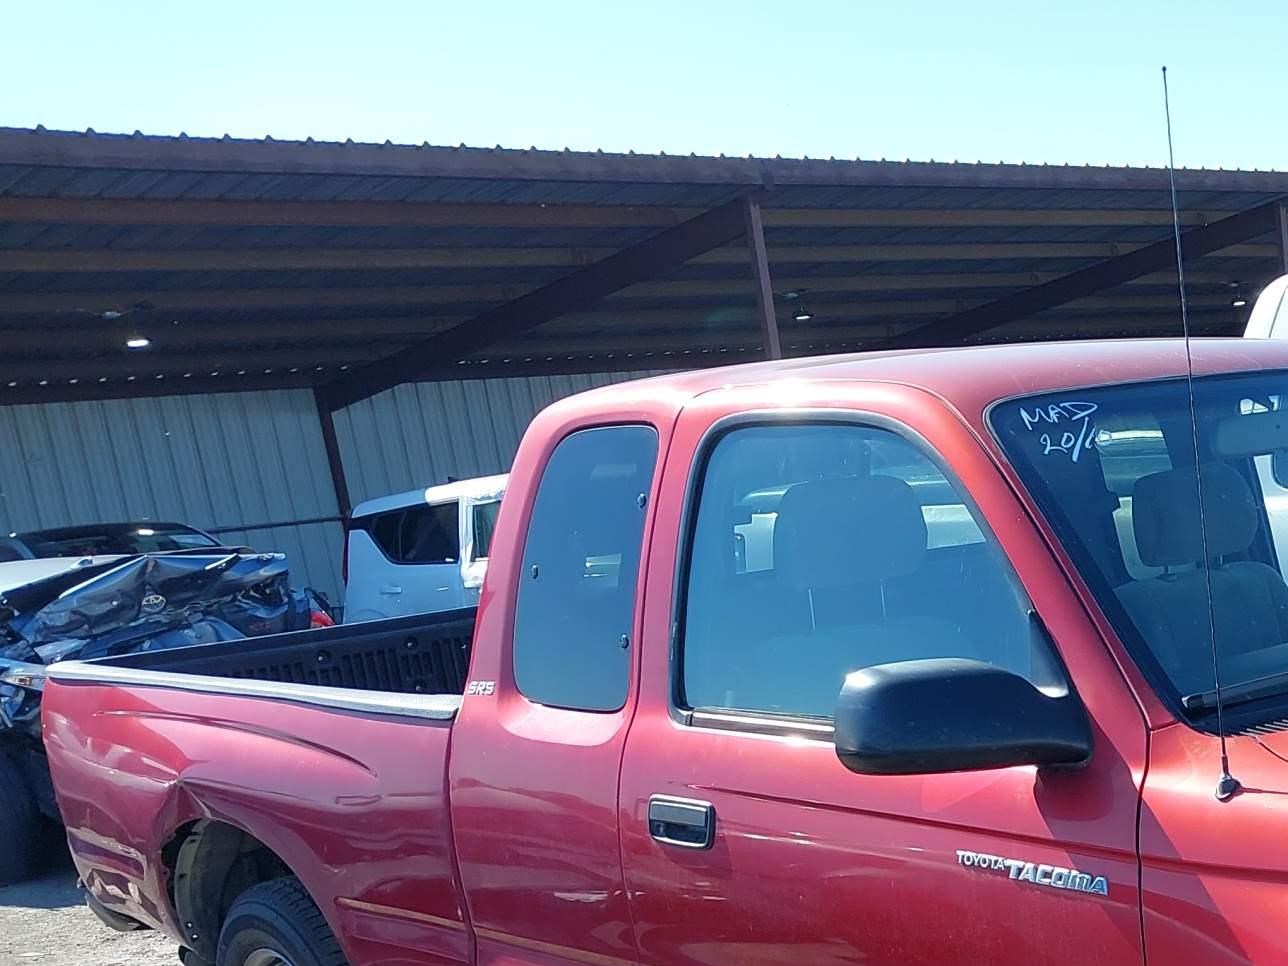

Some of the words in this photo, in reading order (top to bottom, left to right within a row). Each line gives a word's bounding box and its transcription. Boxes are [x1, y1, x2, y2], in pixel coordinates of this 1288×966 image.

[1020, 402, 1098, 430] MAD
[955, 850, 1006, 871] TOYOTA
[1006, 860, 1108, 895] TACOMA
